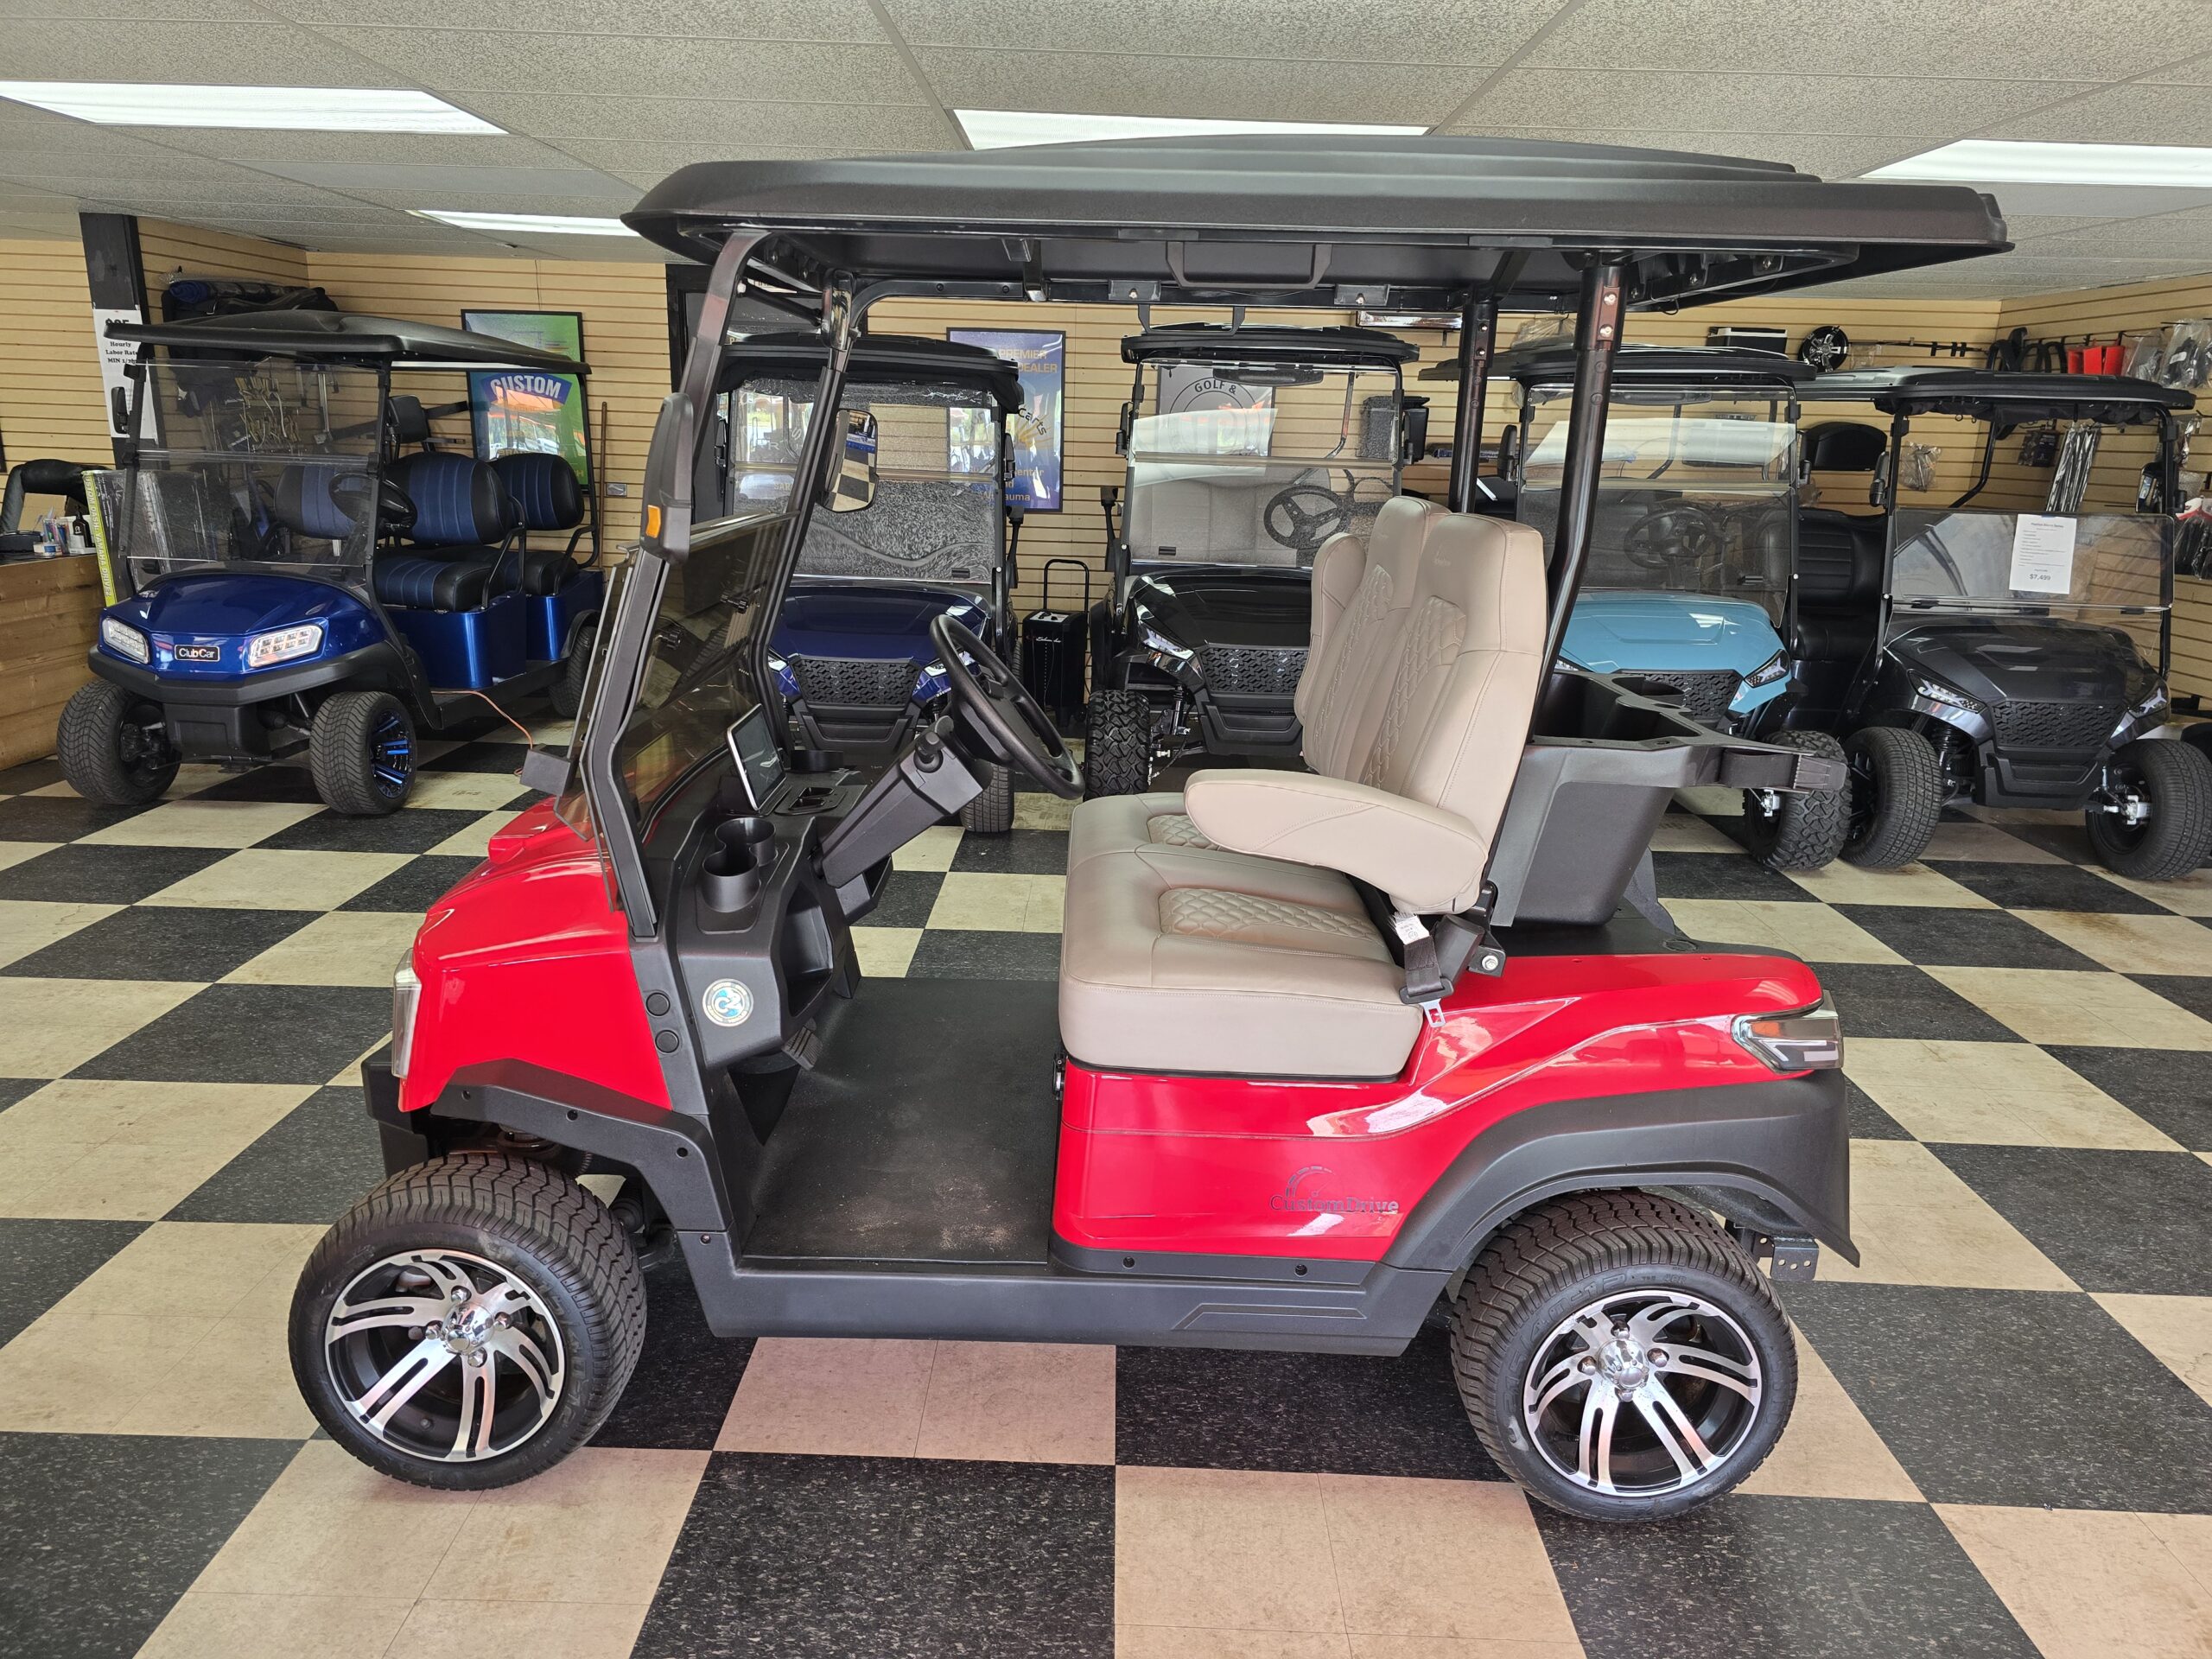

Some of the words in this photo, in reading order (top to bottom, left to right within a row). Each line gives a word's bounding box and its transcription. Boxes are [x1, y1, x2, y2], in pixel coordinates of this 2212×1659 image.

[999, 348, 1047, 359] PREMIER
[1018, 363, 1058, 374] DEALER
[490, 374, 563, 399] CUSTOM
[1194, 380, 1225, 393] GOLF
[1229, 385, 1237, 395] &
[1018, 407, 1047, 435] Carts
[1014, 468, 1045, 477] enter
[94, 532, 107, 566] YAMAHA
